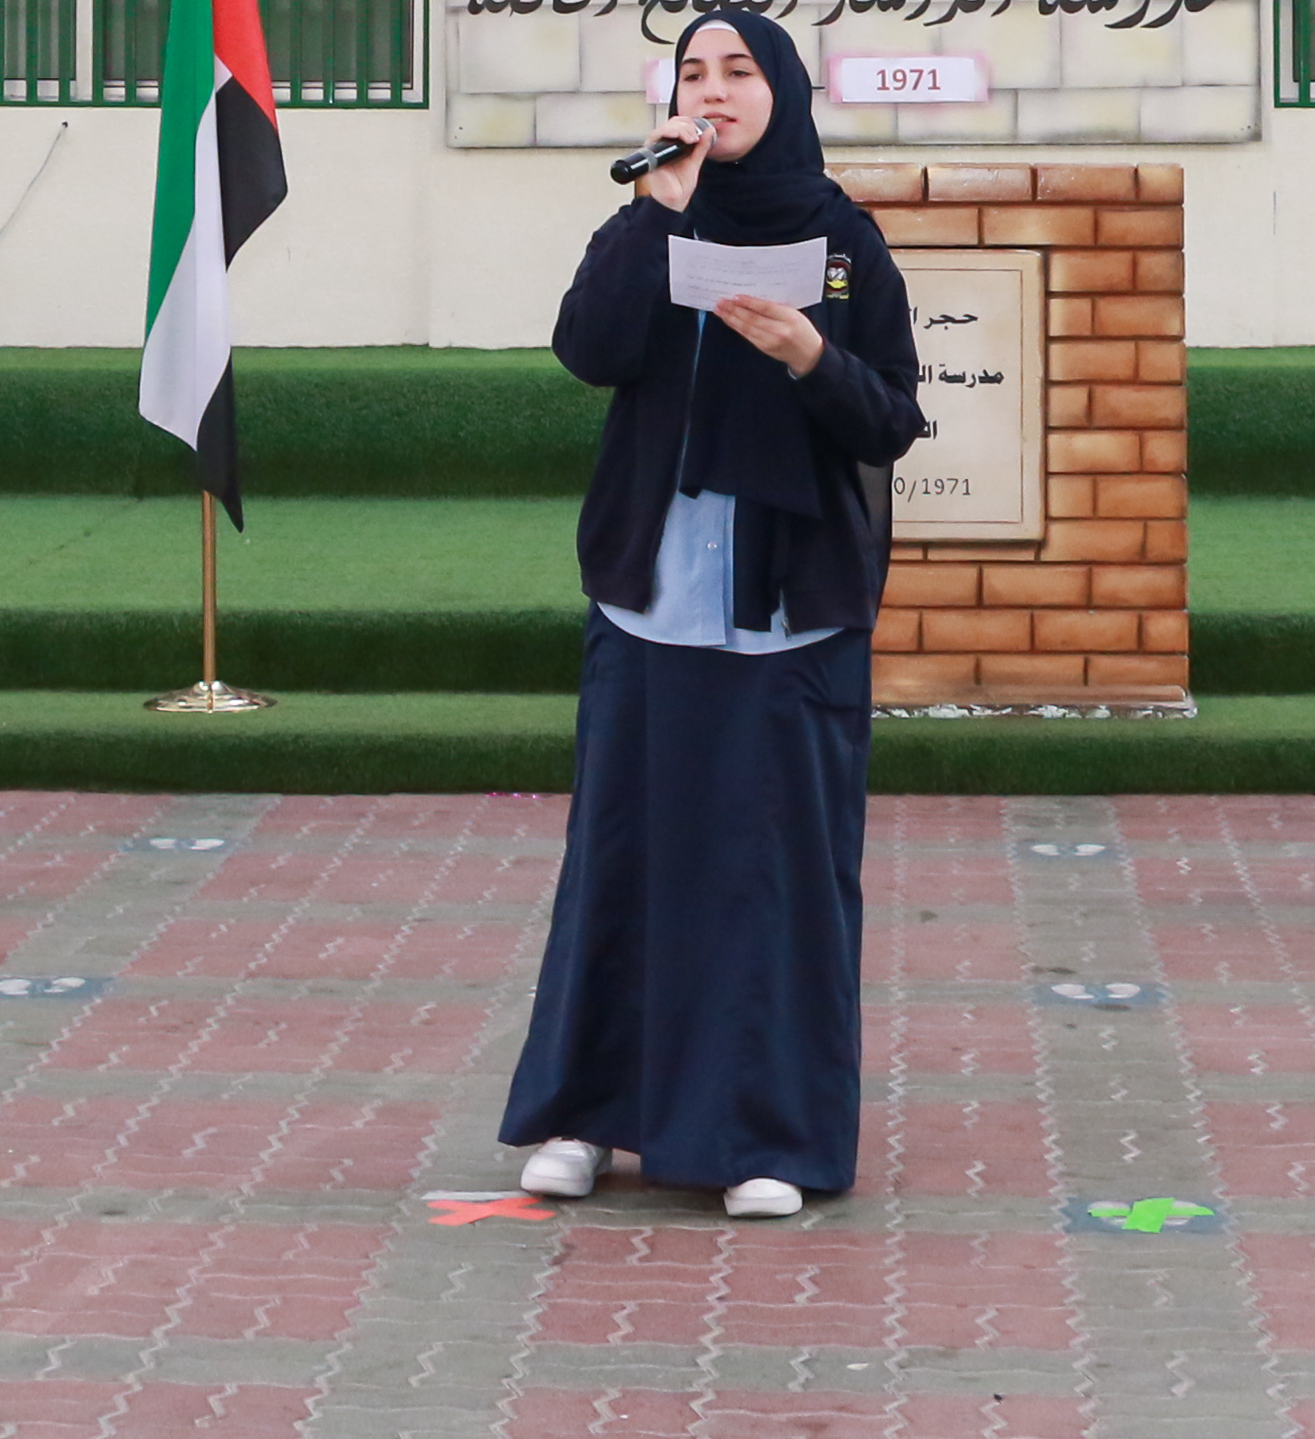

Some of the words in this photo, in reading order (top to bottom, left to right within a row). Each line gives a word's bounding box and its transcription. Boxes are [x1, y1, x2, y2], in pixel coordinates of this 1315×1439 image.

[876, 68, 941, 91] 1971
[923, 313, 979, 331] حجر
[937, 364, 1005, 389] مدرسة
[894, 477, 971, 502] 0/1971
